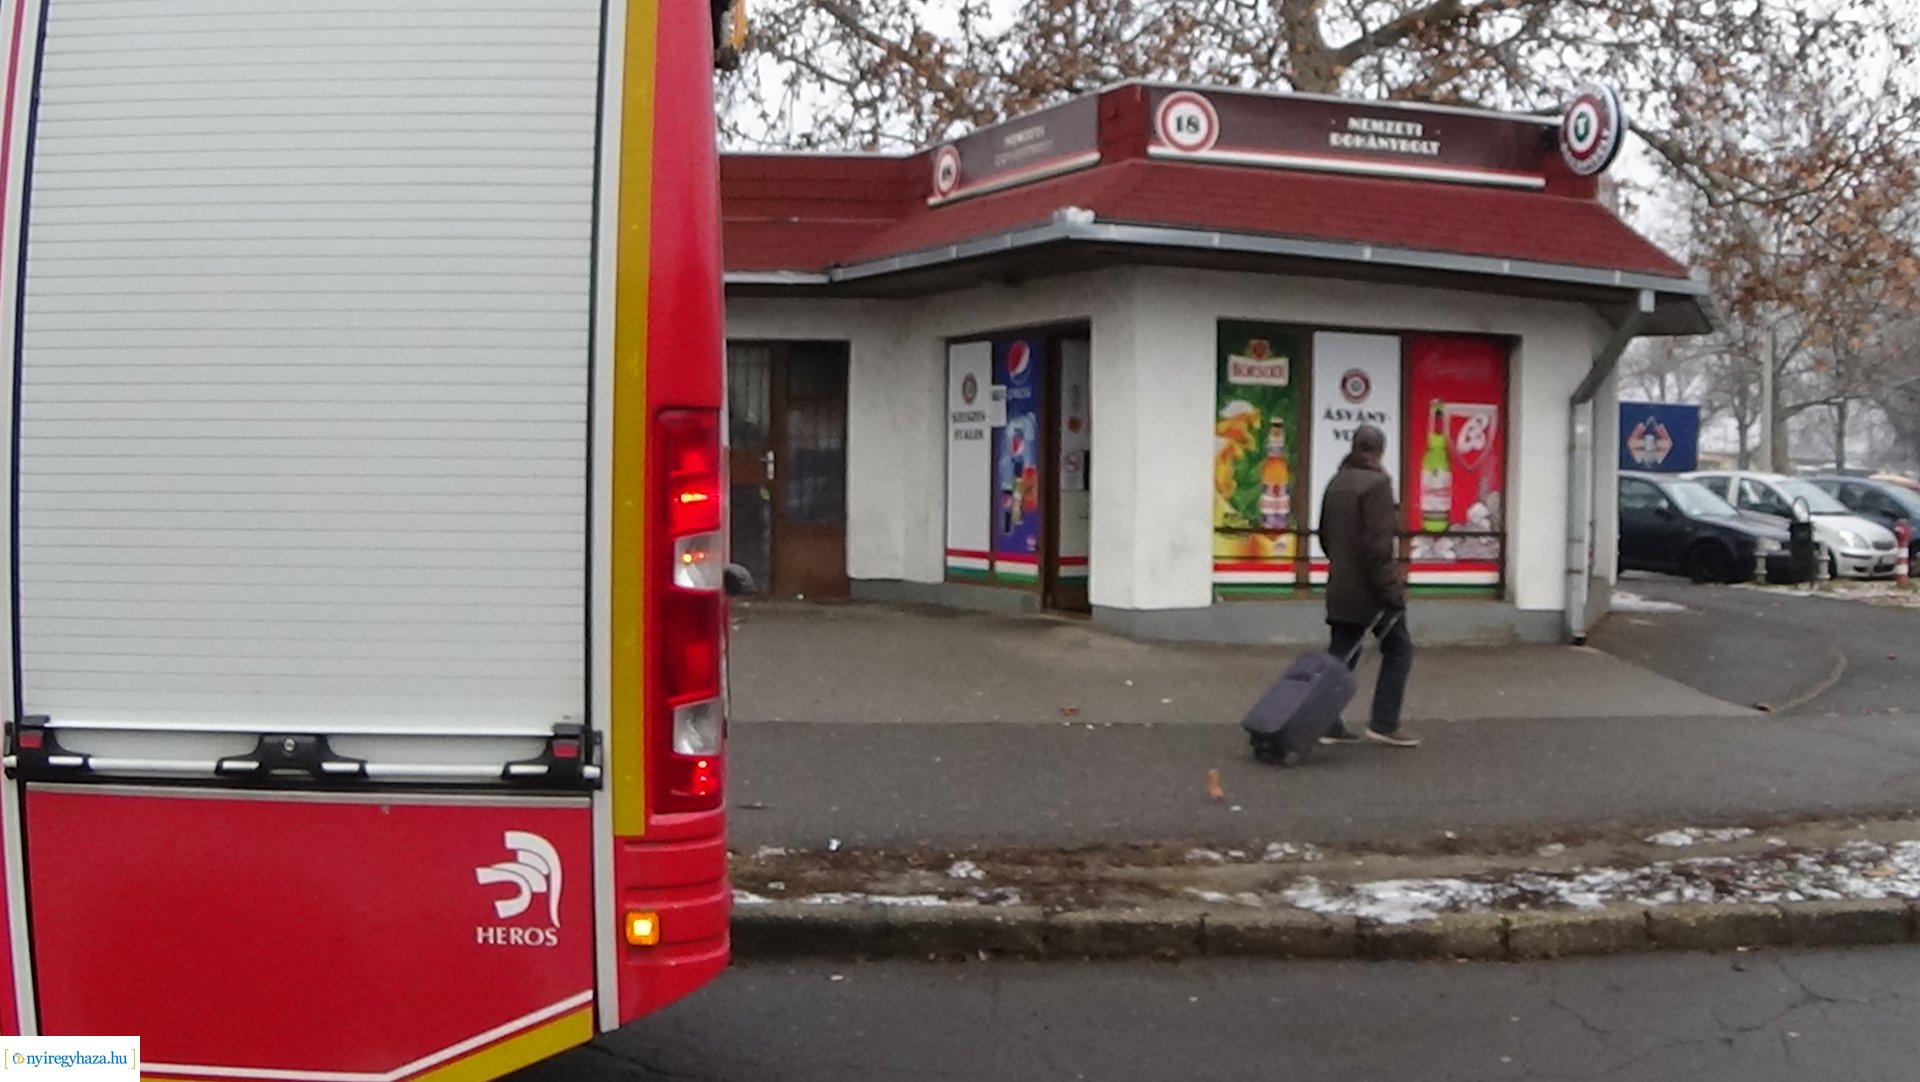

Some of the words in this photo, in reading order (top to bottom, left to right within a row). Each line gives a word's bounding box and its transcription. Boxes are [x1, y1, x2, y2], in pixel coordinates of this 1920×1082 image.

[1176, 114, 1200, 134] 18
[1347, 117, 1423, 137] NEMZETI
[1328, 131, 1441, 156] DOHÁNYBOLT
[476, 926, 559, 947] HEROS
